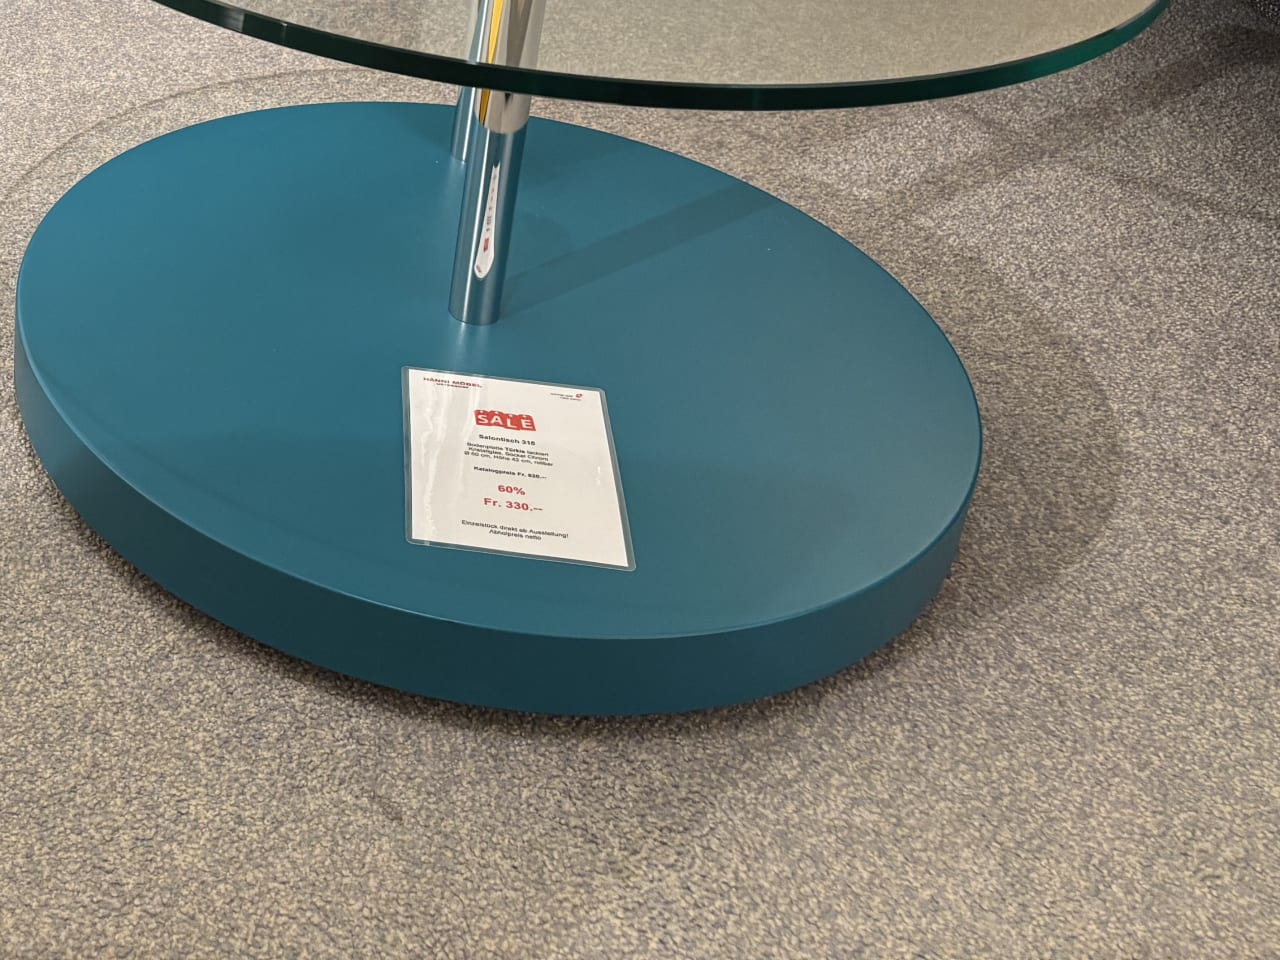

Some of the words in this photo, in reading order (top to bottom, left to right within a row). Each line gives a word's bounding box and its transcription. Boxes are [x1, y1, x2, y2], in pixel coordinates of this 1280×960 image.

[477, 413, 534, 429] SALE
[478, 434, 520, 444] Salontisch
[497, 484, 526, 496] 60%
[483, 497, 502, 508] Fr.
[499, 524, 518, 532] direkt
